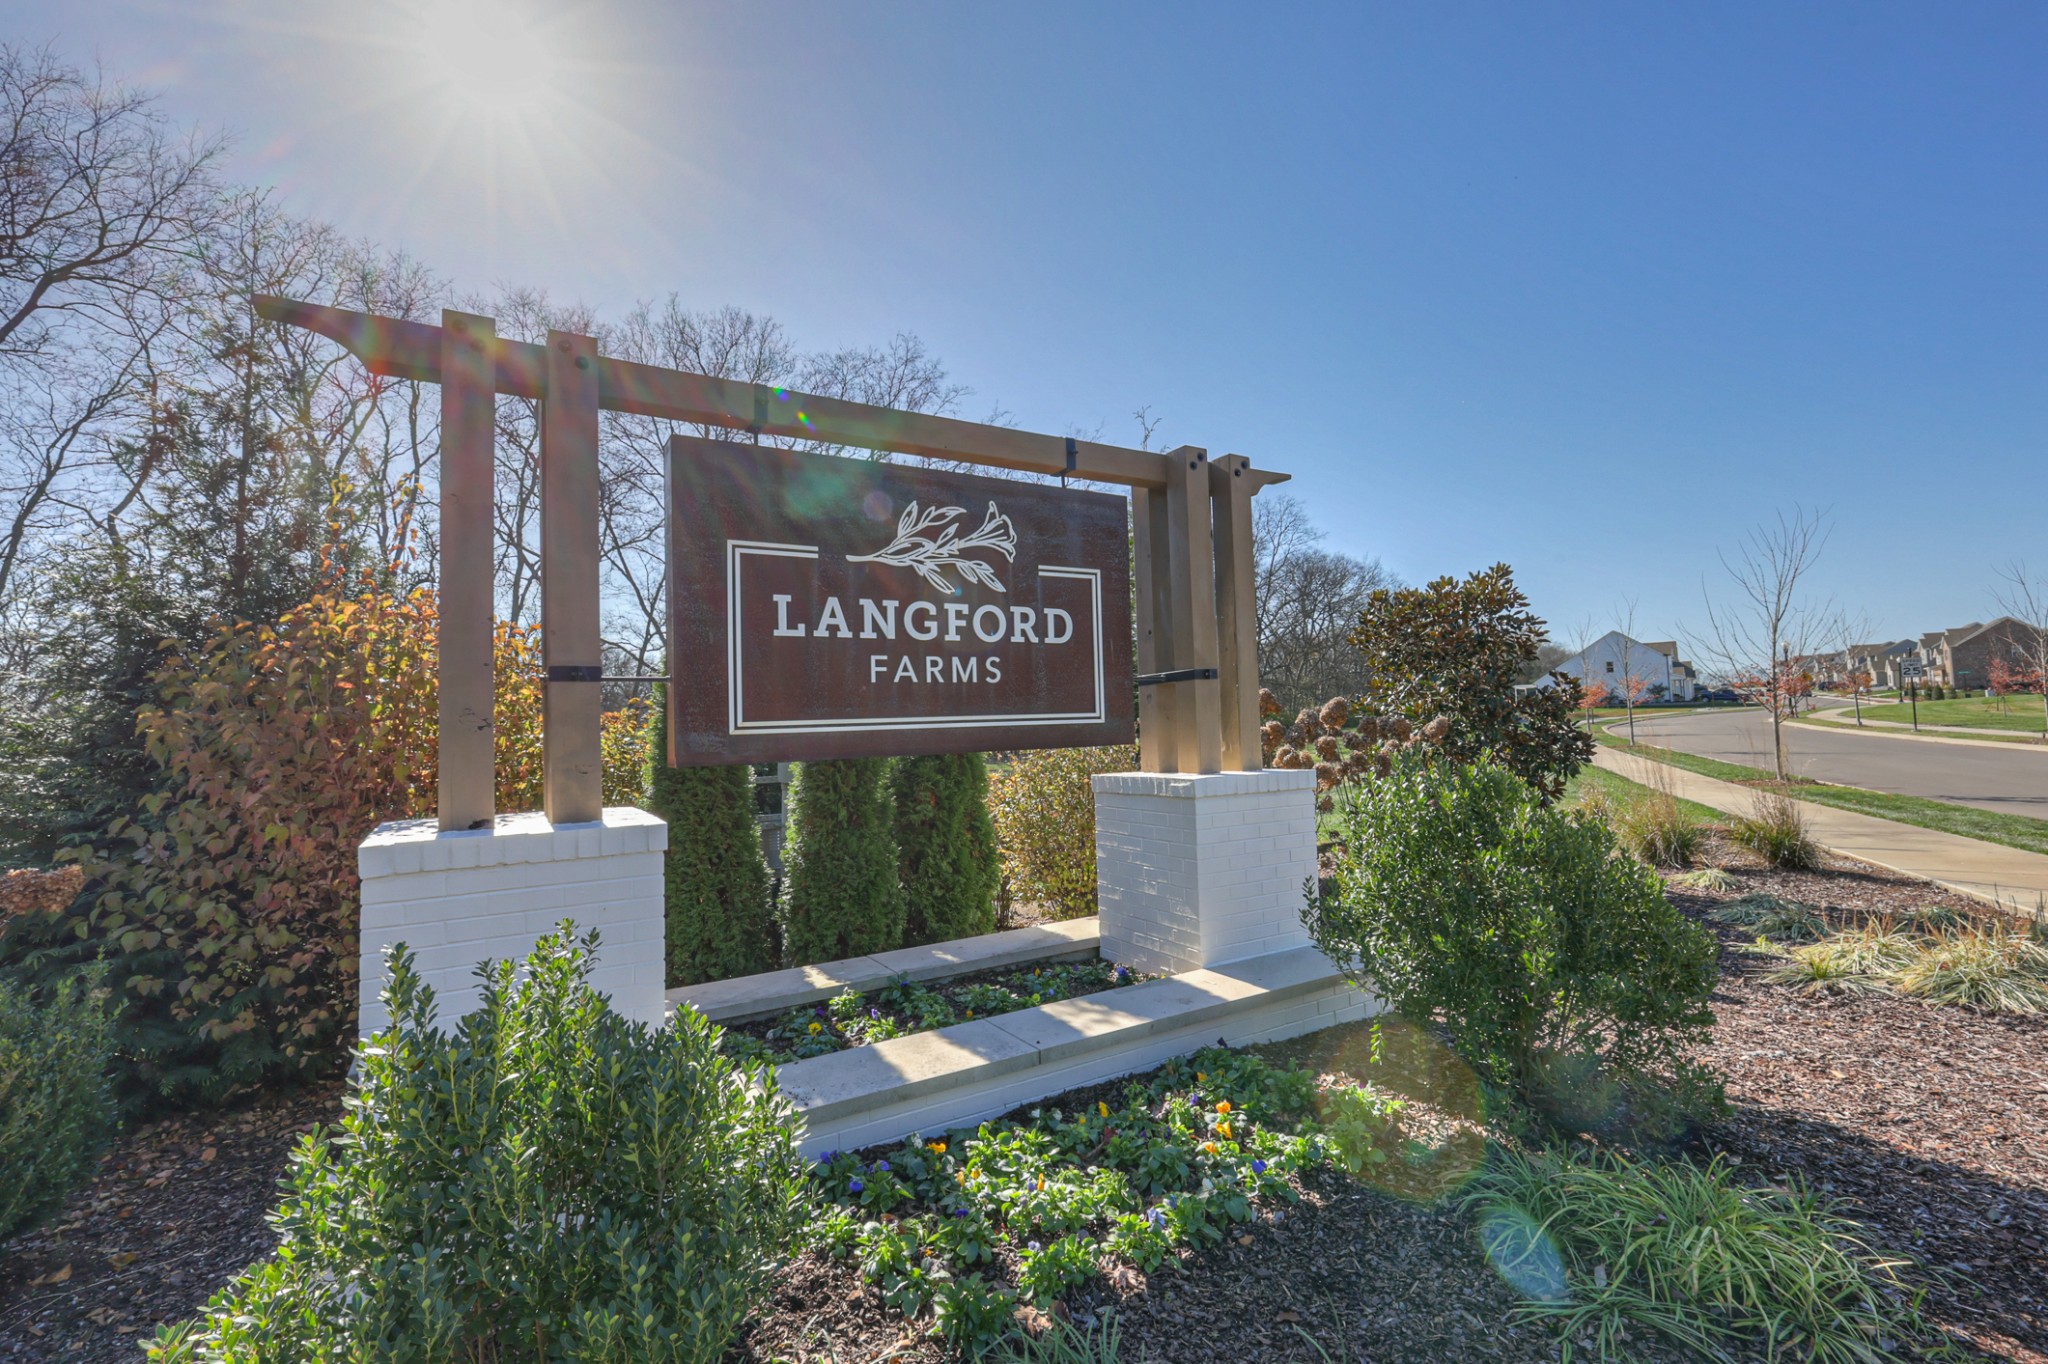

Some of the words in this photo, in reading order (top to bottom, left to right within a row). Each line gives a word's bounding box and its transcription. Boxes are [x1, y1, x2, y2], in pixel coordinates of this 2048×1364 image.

[773, 594, 1073, 644] LANGFORD
[870, 654, 1002, 684] FARMS
[1903, 667, 1921, 675] 25
